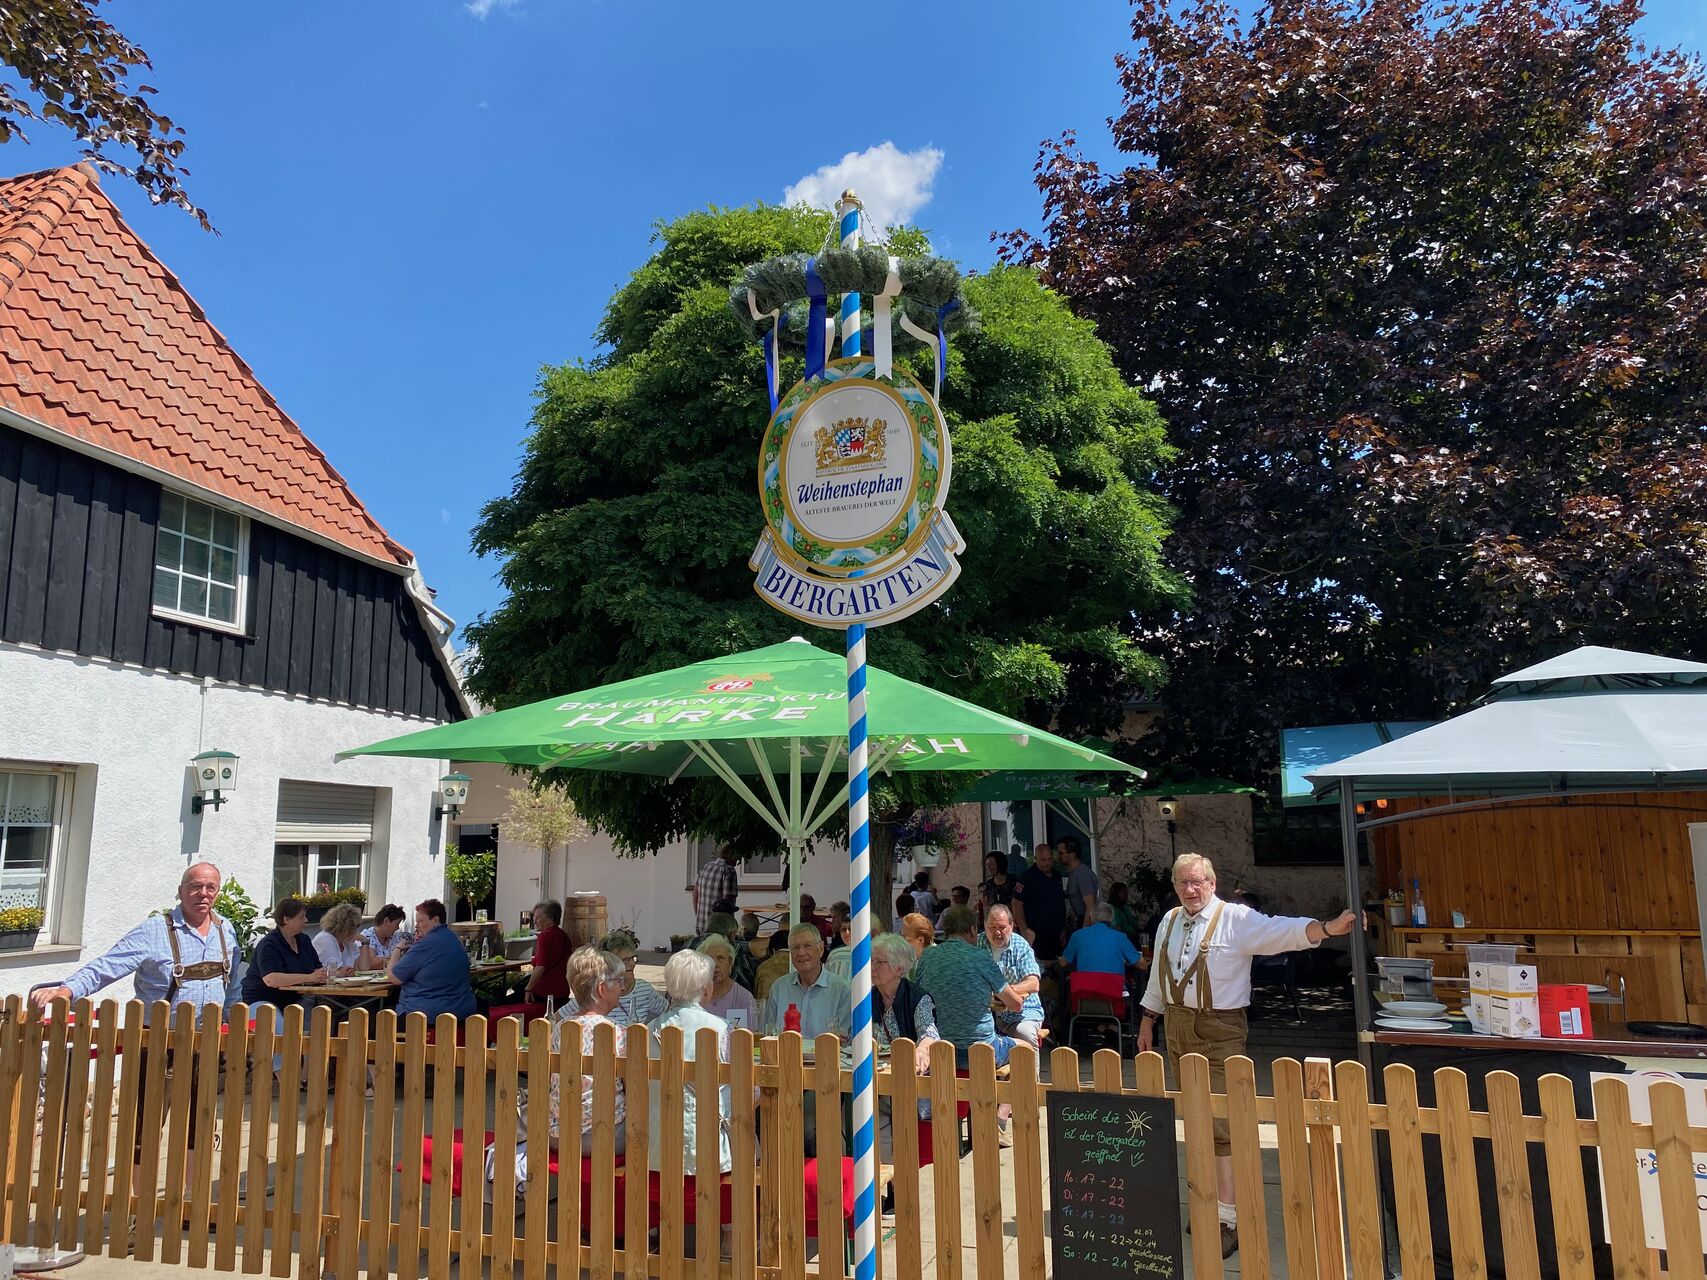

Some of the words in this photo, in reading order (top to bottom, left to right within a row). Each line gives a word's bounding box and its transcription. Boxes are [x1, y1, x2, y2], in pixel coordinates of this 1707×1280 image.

[797, 473, 903, 504] Weihenstephan
[832, 503, 863, 512] BRAUEREI
[762, 549, 943, 616] BIERGARTEN
[554, 691, 871, 711] BRAUMANUFAKTU
[1062, 1107, 1098, 1121] Scheint
[1102, 1111, 1119, 1123] die
[1064, 1128, 1076, 1139] ist
[1080, 1130, 1095, 1141] der
[1096, 1131, 1145, 1151] Biergarten
[1082, 1149, 1123, 1165] geöffnet
[1081, 1173, 1095, 1184] 17
[1109, 1177, 1124, 1190] 22
[1081, 1193, 1094, 1203] 17
[1109, 1196, 1124, 1208] 22
[1081, 1210, 1094, 1219] 17
[1109, 1213, 1124, 1225] 22
[1082, 1230, 1095, 1241] 14
[1110, 1234, 1125, 1245] 22
[1084, 1252, 1098, 1262] 12
[1112, 1256, 1127, 1269] 21
